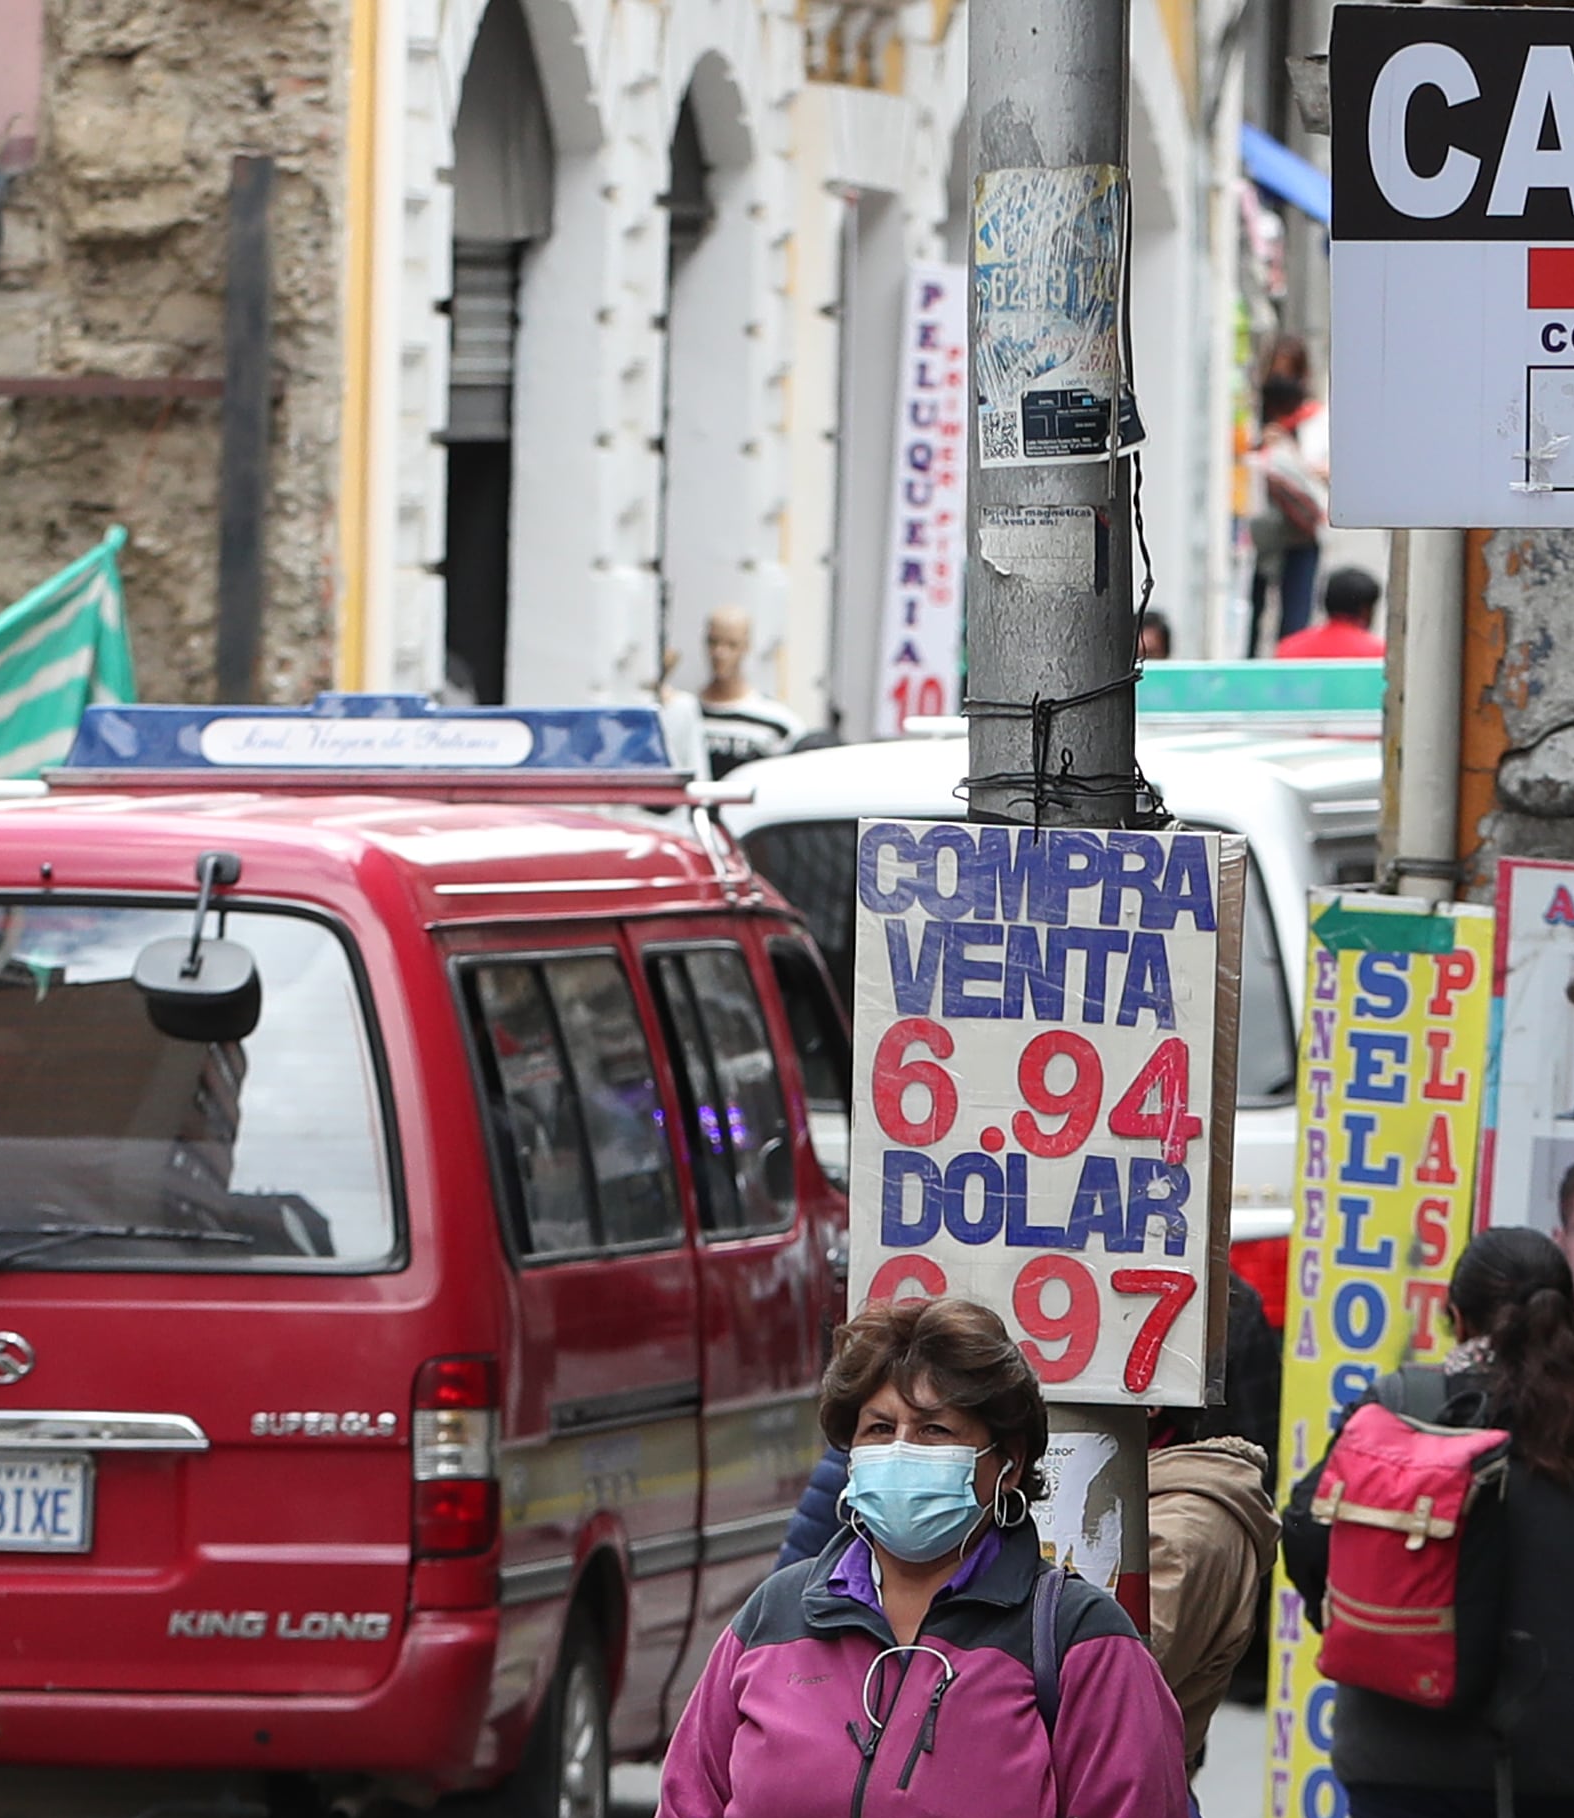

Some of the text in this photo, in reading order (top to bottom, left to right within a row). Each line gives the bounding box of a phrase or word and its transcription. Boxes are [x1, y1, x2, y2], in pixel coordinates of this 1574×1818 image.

[894, 281, 947, 665] PELUQUERIA
[858, 823, 1218, 932] COMPRA
[884, 918, 1176, 1030] VENTA
[871, 1017, 1203, 1166] 6.94
[1295, 950, 1337, 1359] ENTREGA
[880, 1149, 1192, 1256] DOLAR
[1330, 951, 1410, 1430] SELLOS
[167, 1610, 392, 1641] KING LONG
